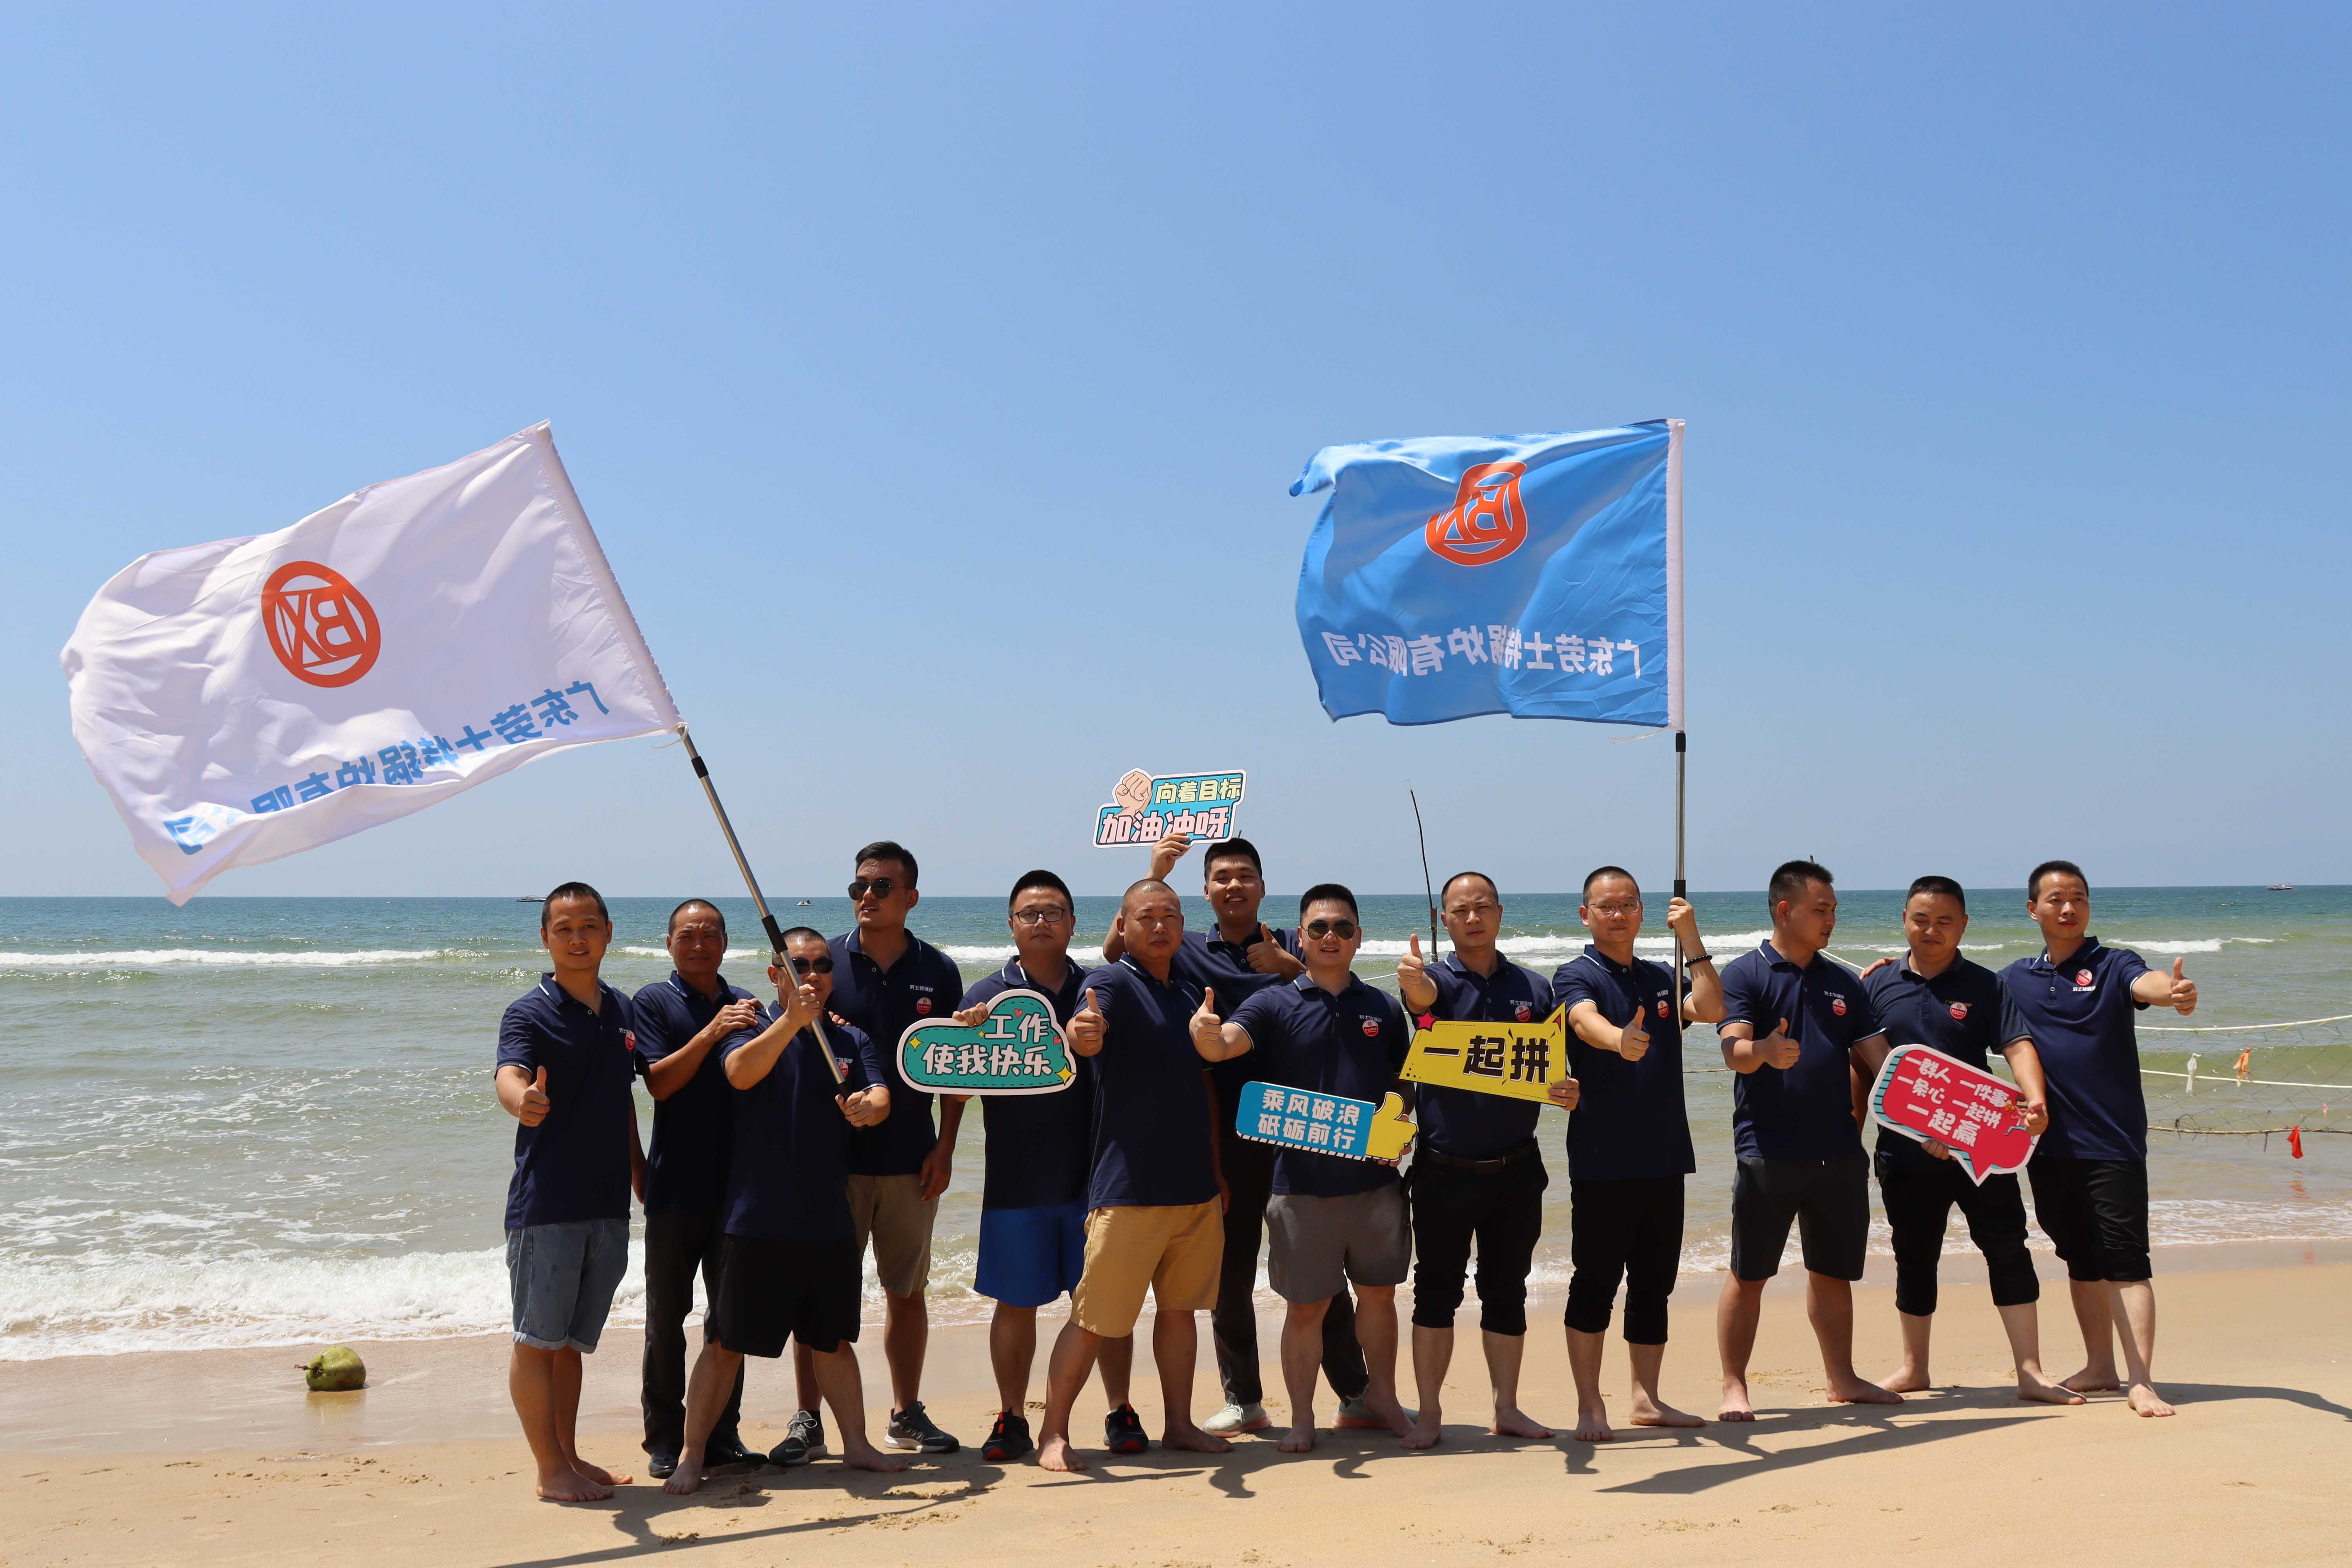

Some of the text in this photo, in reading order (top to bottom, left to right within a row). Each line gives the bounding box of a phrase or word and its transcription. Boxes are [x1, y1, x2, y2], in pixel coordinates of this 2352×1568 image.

[1154, 778, 1242, 804] 向着目标
[1099, 806, 1230, 844] 加油冲呀
[985, 1013, 1051, 1043] 工作
[922, 1043, 1053, 1077] 使我快乐
[1423, 1035, 1550, 1085] 一起拼
[1905, 1056, 2009, 1108] 一群人 一件事
[1262, 1089, 1360, 1126] 乘风破浪
[1897, 1075, 2002, 1129] 一条心 一起拼
[1257, 1113, 1356, 1150] 砥砺前行
[1906, 1103, 1982, 1147] 一起赢
